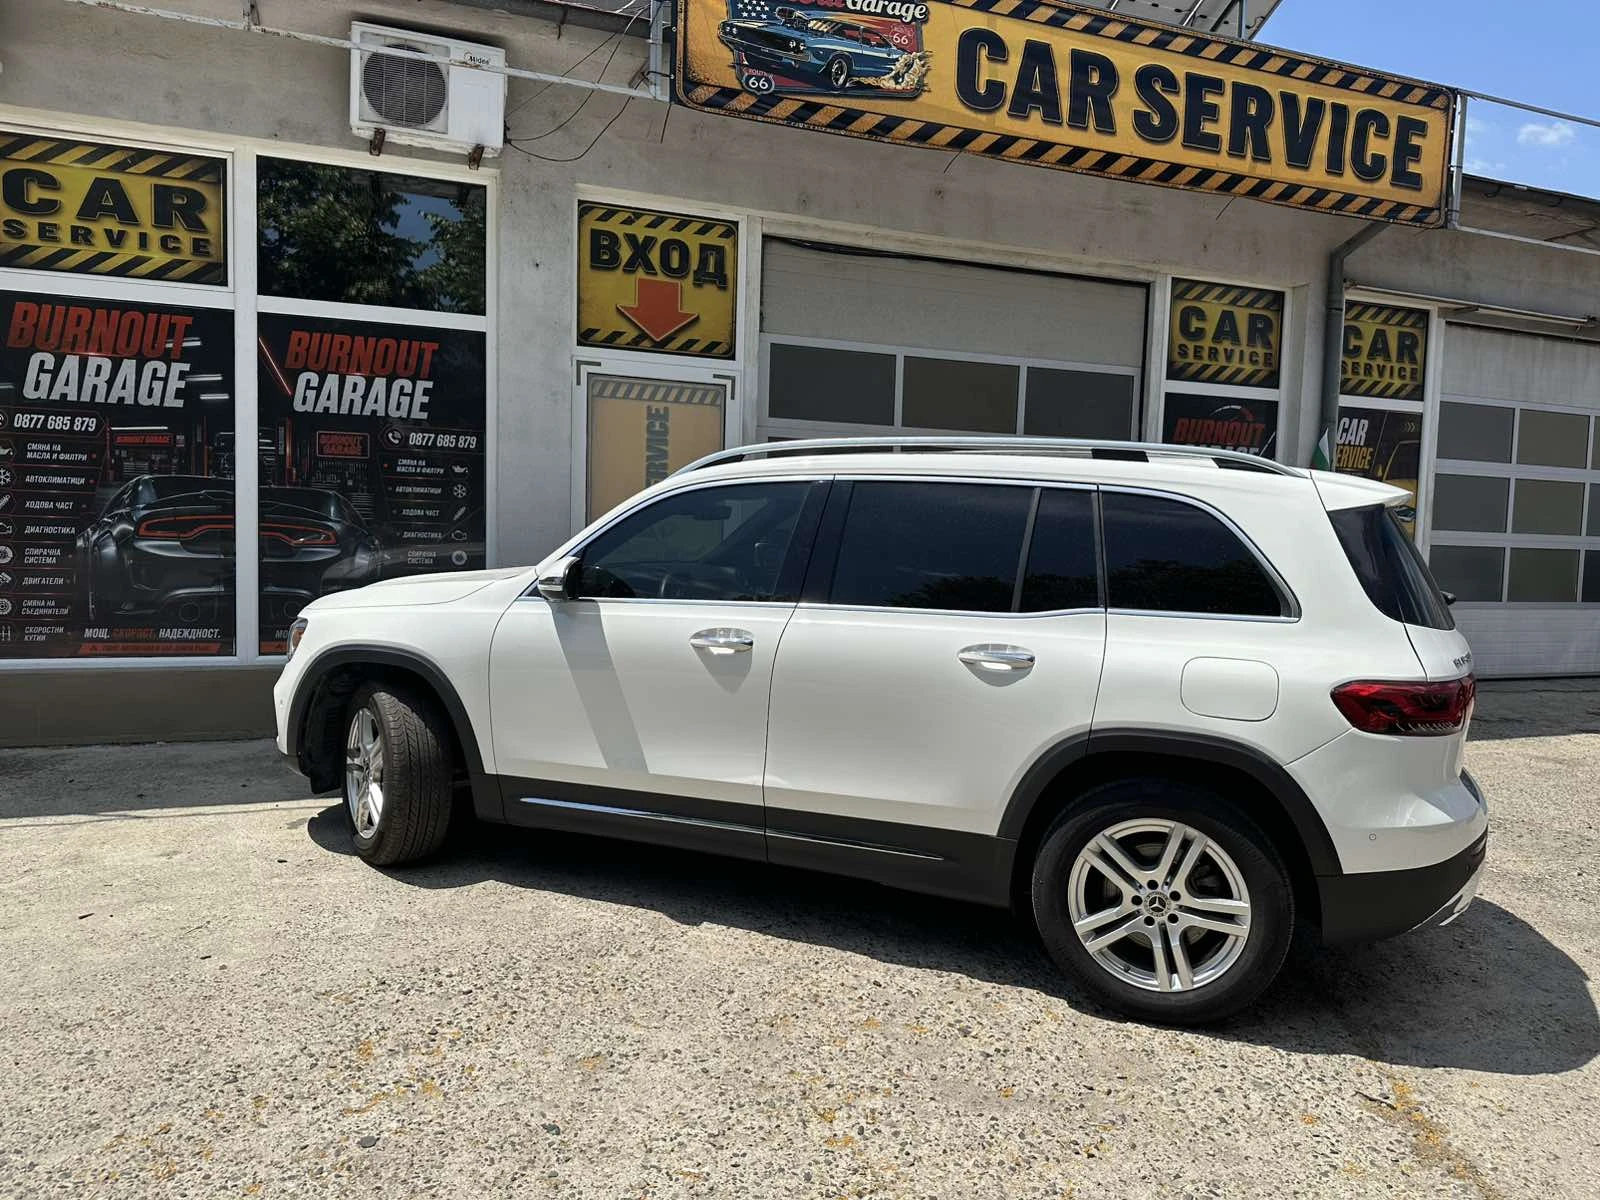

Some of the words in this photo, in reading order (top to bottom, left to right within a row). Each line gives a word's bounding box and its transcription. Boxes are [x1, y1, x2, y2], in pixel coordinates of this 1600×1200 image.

[893, 33, 909, 45] 66
[749, 77, 768, 89] 66
[955, 26, 1118, 133] CAR
[1131, 62, 1429, 191] SERVICE
[3, 168, 208, 232] CAR
[3, 219, 212, 257] SERVICE
[590, 228, 728, 288] ВХОД
[7, 301, 193, 361] BURNOUT
[1179, 305, 1275, 349] CAR
[285, 330, 439, 379] BURNOUT
[1177, 343, 1274, 369] SERVICE
[1343, 325, 1420, 364] CAR
[22, 352, 191, 408] GARAGE
[1341, 359, 1419, 382] SERVICE
[292, 371, 434, 420] GARAGE
[13, 413, 46, 429] 0877
[46, 415, 71, 431] 685
[73, 416, 97, 432] 879
[1173, 417, 1266, 449] BURNOUT
[1336, 417, 1369, 446] CAR
[27, 443, 51, 452] СМЯНА
[52, 444, 62, 452] НА
[409, 433, 435, 447] 0877
[436, 434, 457, 448] 685
[458, 436, 477, 449] 879
[646, 405, 669, 489] RVICE
[27, 452, 51, 460] МАСЛА
[58, 453, 88, 462] ФИЛТРИ
[1336, 445, 1374, 469] ERVICE
[25, 475, 85, 486] АВТОКЛИМАТИЦИ
[24, 501, 55, 510] ХОДОВА
[56, 501, 74, 510] ЧАСТ
[24, 525, 76, 535] ДИАГНОСТИКА
[24, 548, 61, 556] СПИРАЧНА
[24, 556, 57, 564] СИСТЕМА
[22, 577, 64, 586] ДВИГАТЕЛИ
[22, 599, 45, 607] СМЯНА
[24, 625, 65, 634] СКОРОСТНИ
[84, 628, 110, 640] МОЩ.
[158, 628, 221, 640] НАДЕЖДНОСТ.
